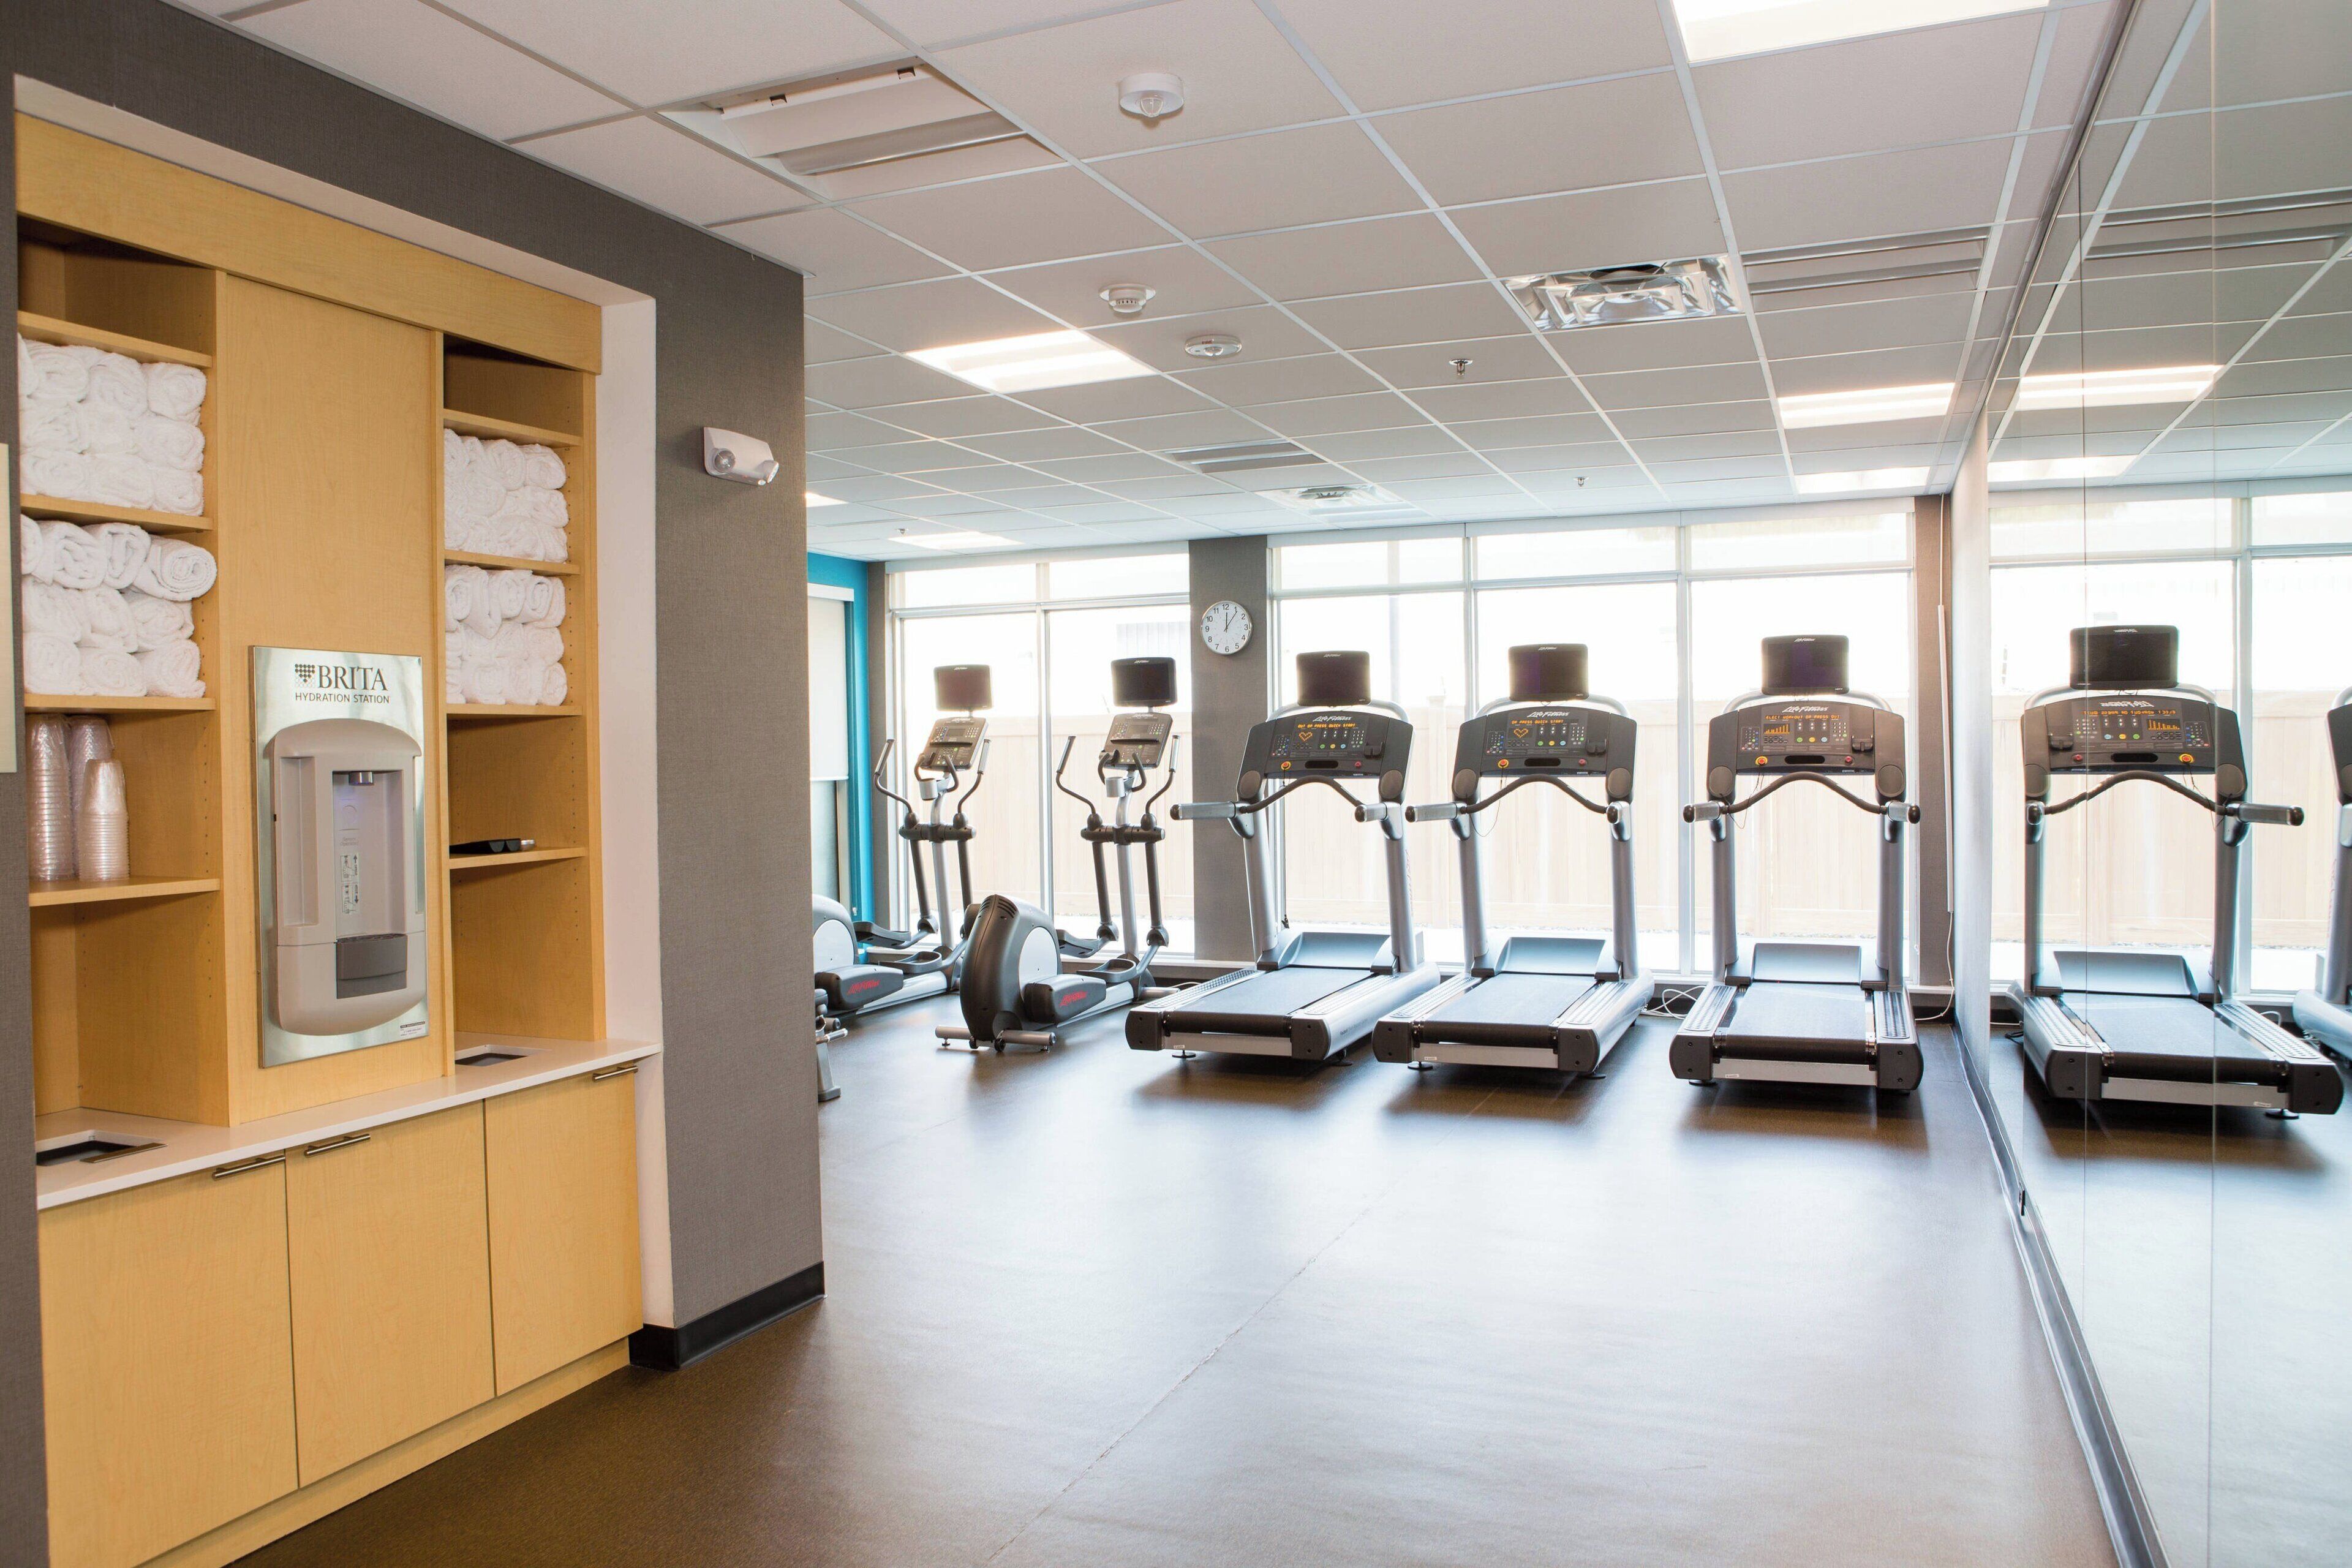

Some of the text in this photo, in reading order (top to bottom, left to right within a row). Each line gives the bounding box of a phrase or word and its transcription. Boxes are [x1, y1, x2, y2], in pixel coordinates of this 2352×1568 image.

[318, 665, 388, 691] BRITA
[295, 692, 390, 704] HYDRATION STATION
